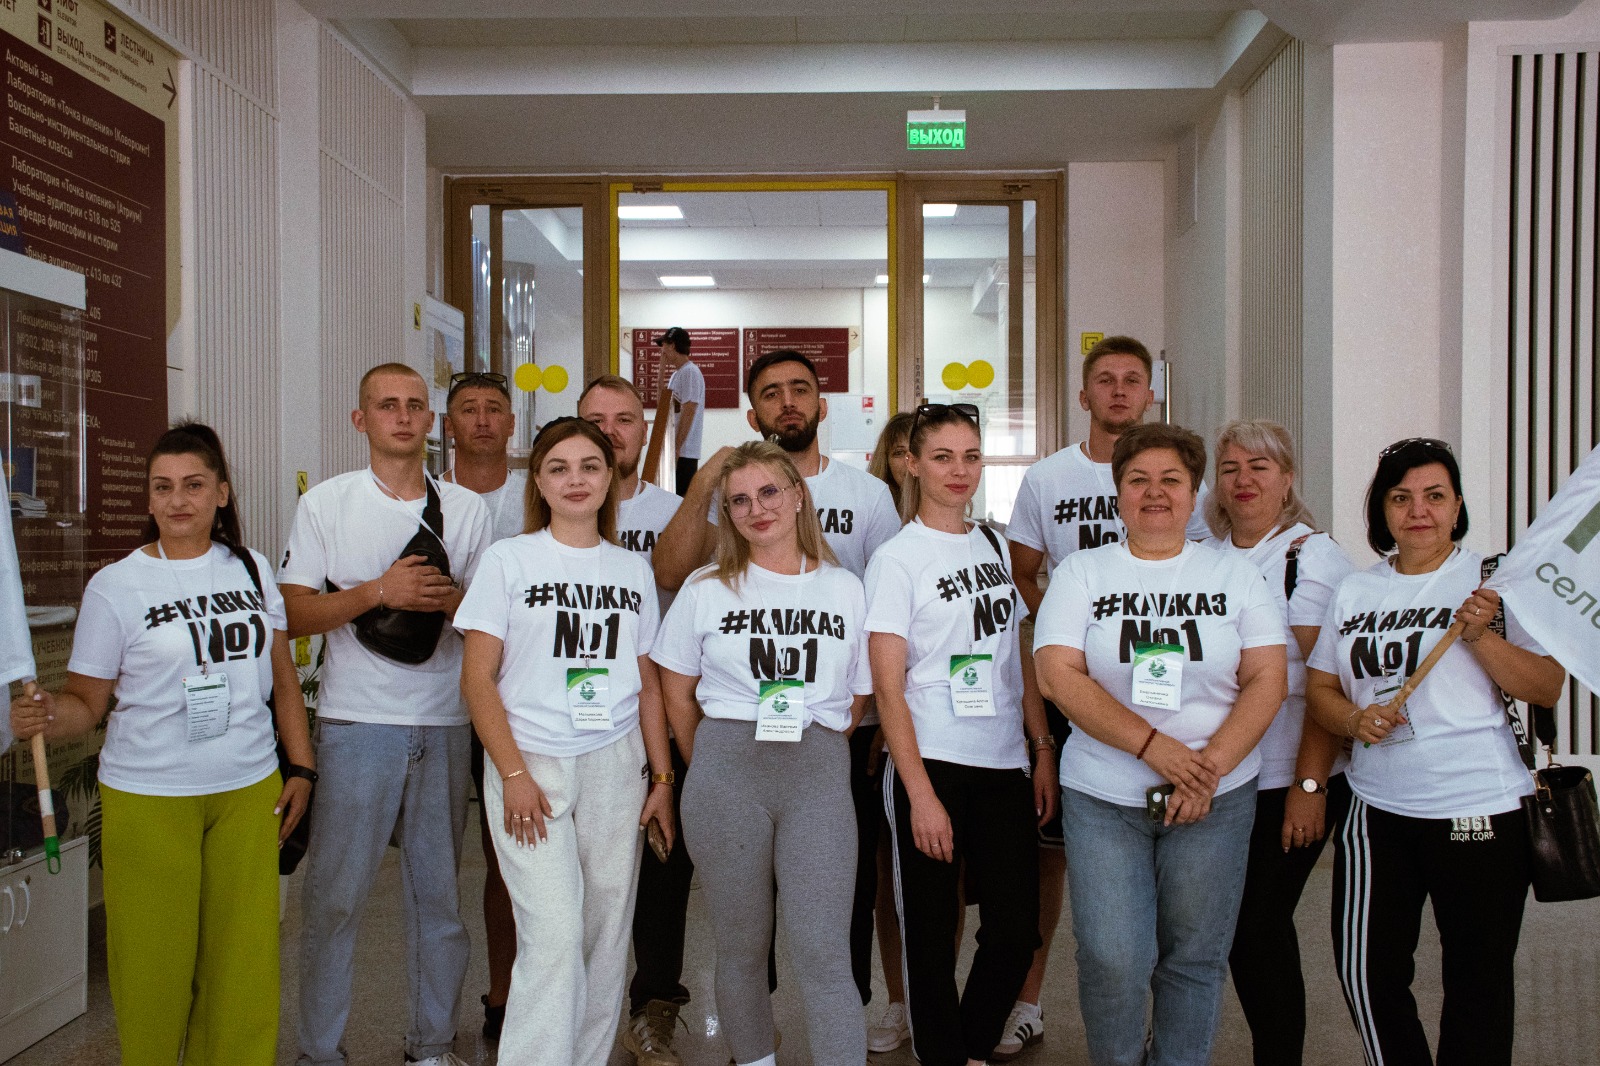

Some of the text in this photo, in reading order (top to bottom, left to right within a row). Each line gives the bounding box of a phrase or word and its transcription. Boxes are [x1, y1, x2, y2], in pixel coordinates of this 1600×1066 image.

[57, 27, 85, 57] ВЫХОД
[120, 33, 155, 66] ЛЕСТНИЦА
[6, 48, 54, 87] Актовый зал
[7, 71, 56, 109] Лаборатория
[9, 116, 74, 159] Балетные классы
[909, 128, 964, 148] ВЫХОД
[11, 155, 60, 188] Лаборатория
[109, 148, 131, 167] студия
[12, 177, 46, 203] Учебные
[47, 195, 83, 218] аудитории
[88, 209, 101, 225] 518
[101, 217, 110, 229] по
[15, 201, 46, 227] афедра
[47, 214, 87, 240] философии
[86, 348, 99, 363] 317
[524, 582, 643, 616] #КАВКАЗ
[1092, 592, 1228, 621] #КАВКАЗ
[718, 608, 846, 641] #КАВКАЗ
[1339, 606, 1455, 638] #КАВКА
